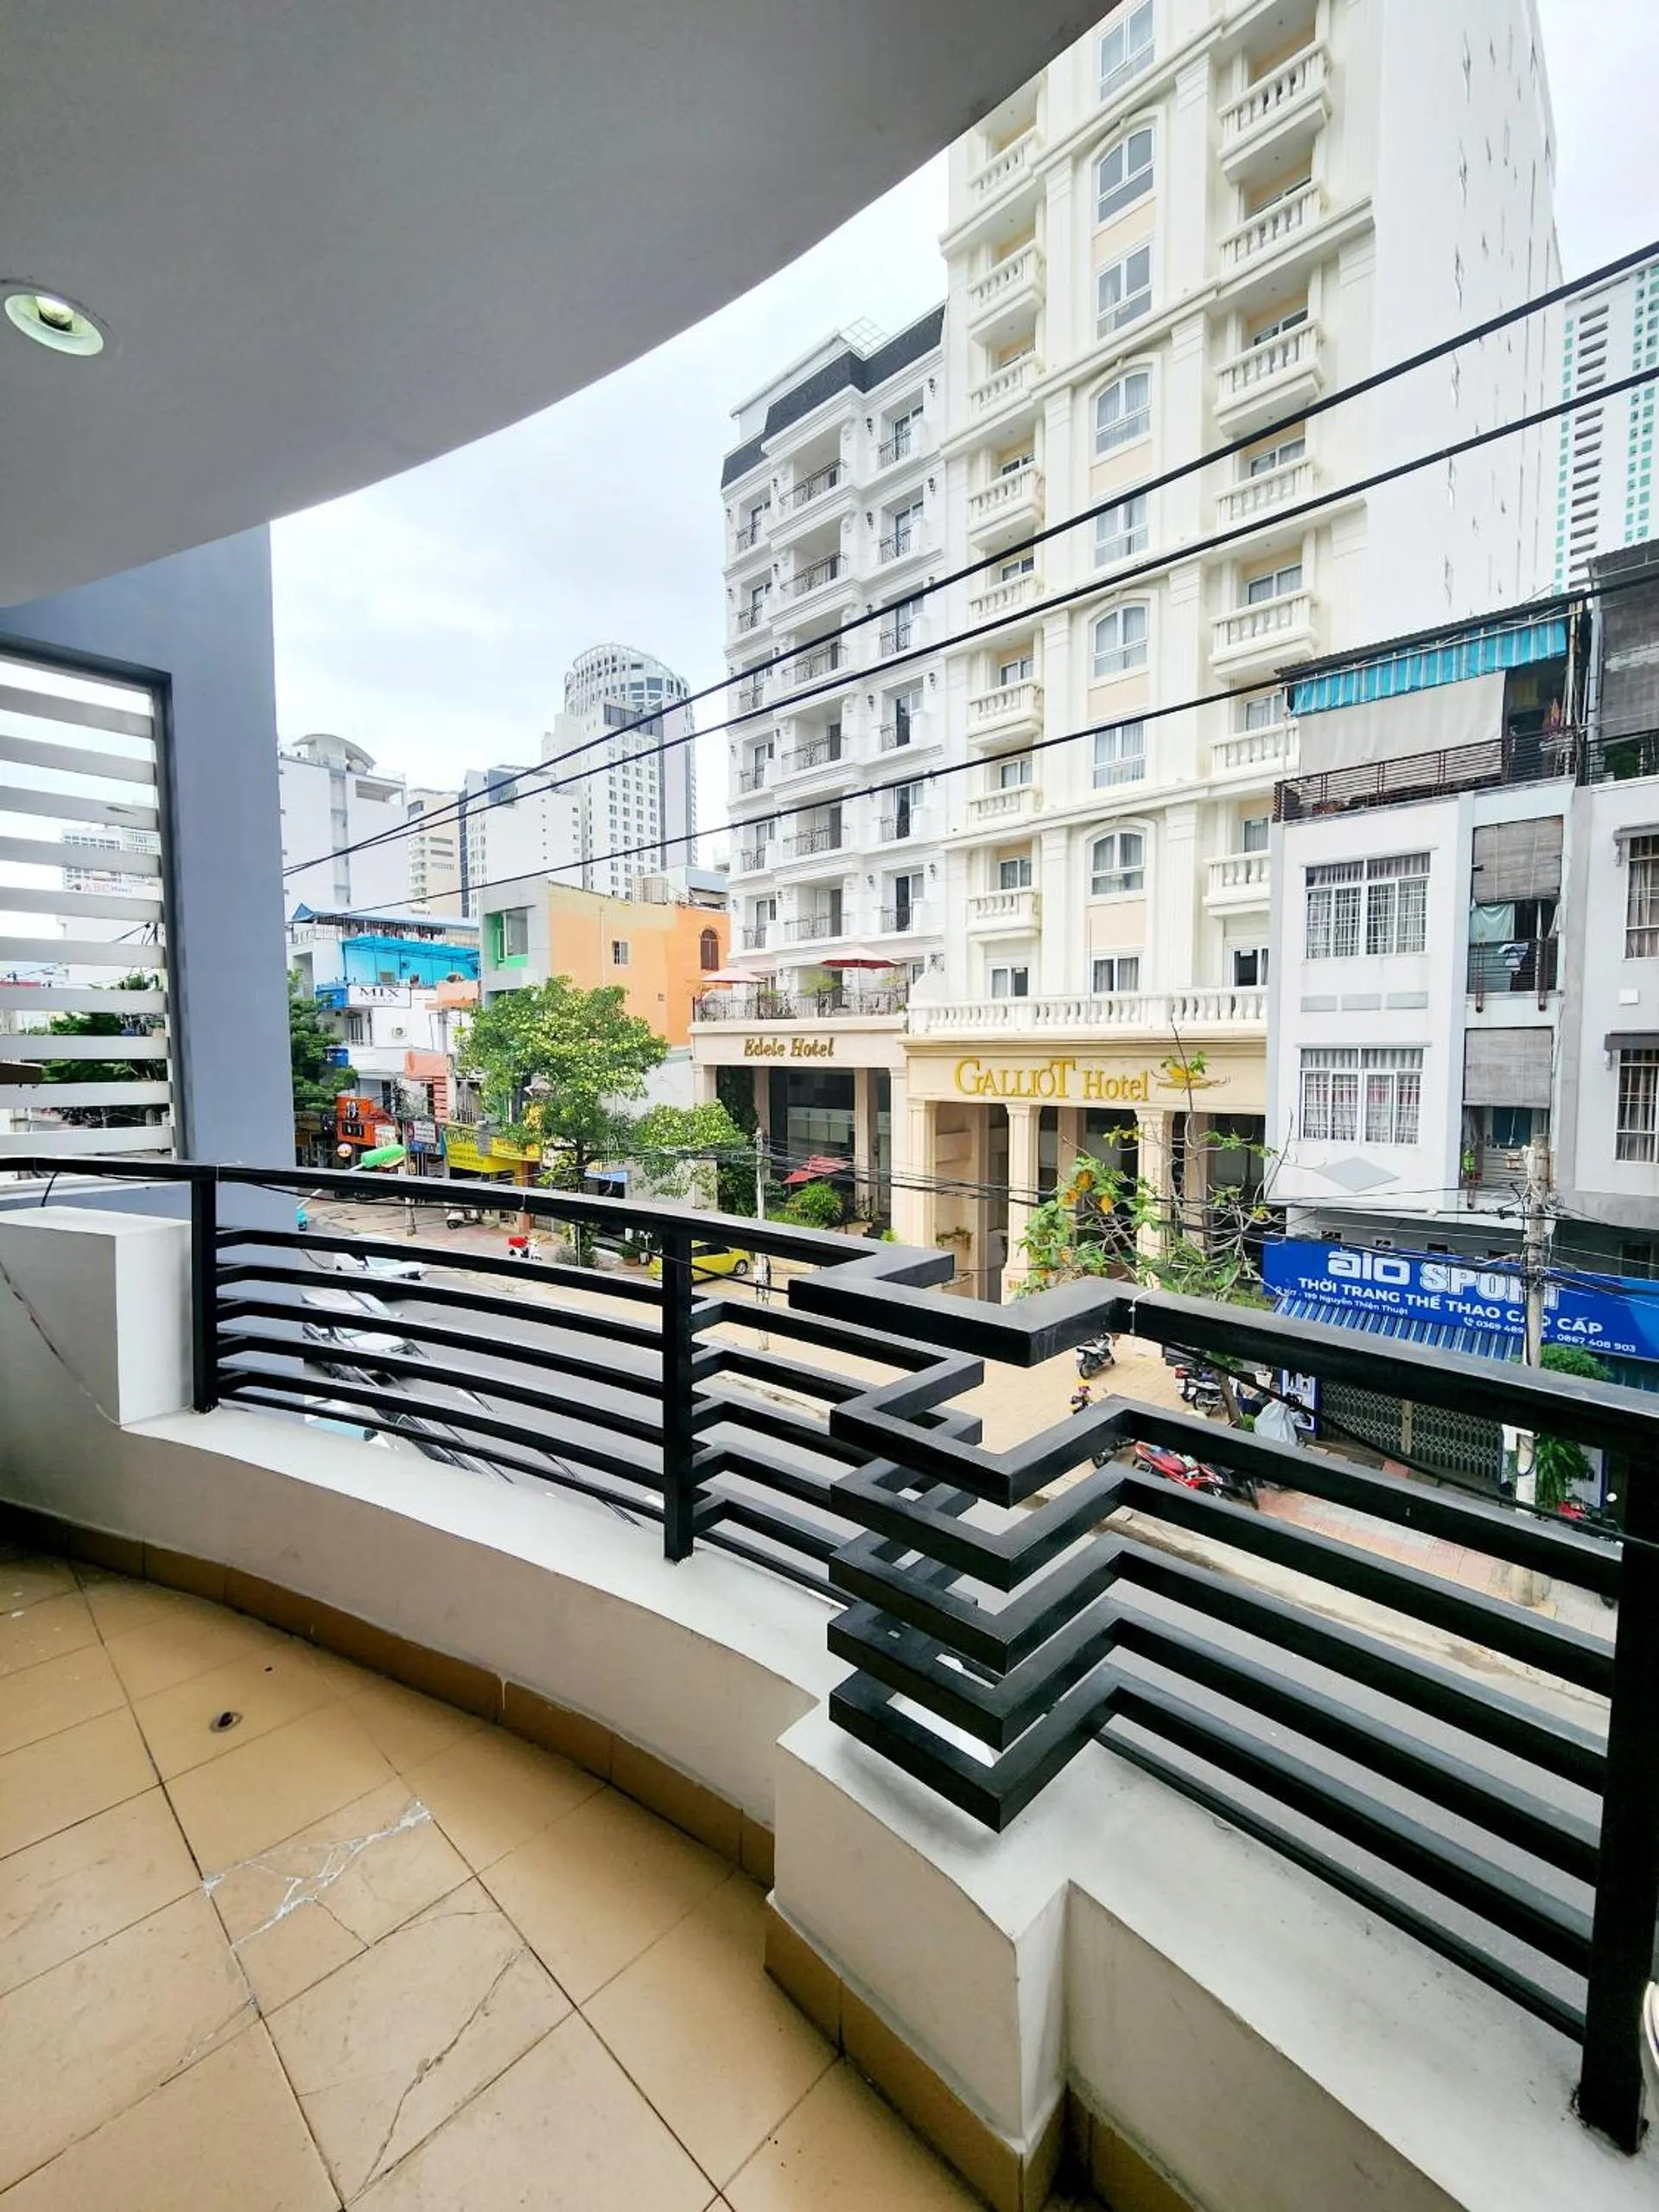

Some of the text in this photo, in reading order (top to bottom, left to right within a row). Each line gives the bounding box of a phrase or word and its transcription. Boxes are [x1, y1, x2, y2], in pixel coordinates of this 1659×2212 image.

[359, 987, 400, 998] MIX
[744, 1037, 835, 1058] Edele Hotel
[1083, 1070, 1150, 1102] Hotel
[1341, 1284, 1400, 1304] TRANG
[1446, 1300, 1501, 1319] THAO
